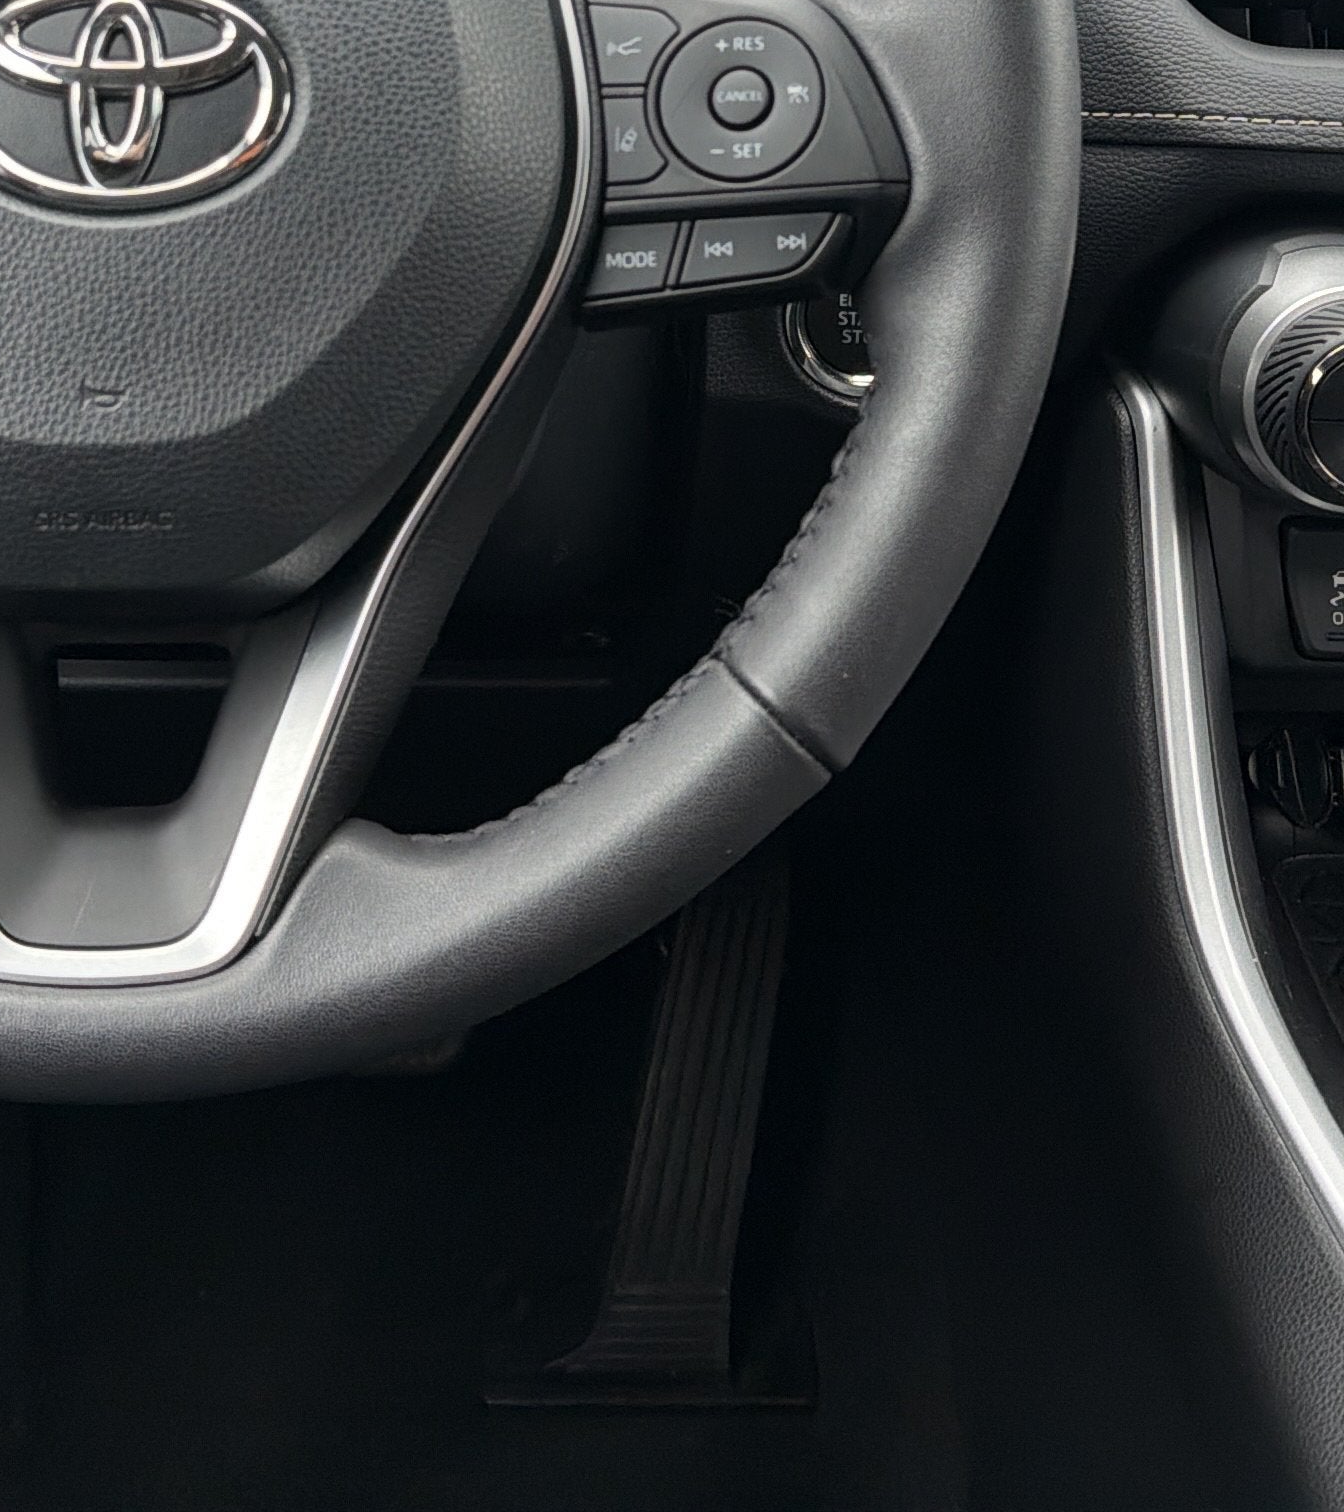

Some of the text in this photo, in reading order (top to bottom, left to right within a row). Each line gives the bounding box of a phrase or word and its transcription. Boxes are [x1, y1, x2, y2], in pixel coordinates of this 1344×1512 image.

[732, 35, 765, 51] RES
[732, 142, 763, 159] SET
[605, 250, 658, 269] MODE
